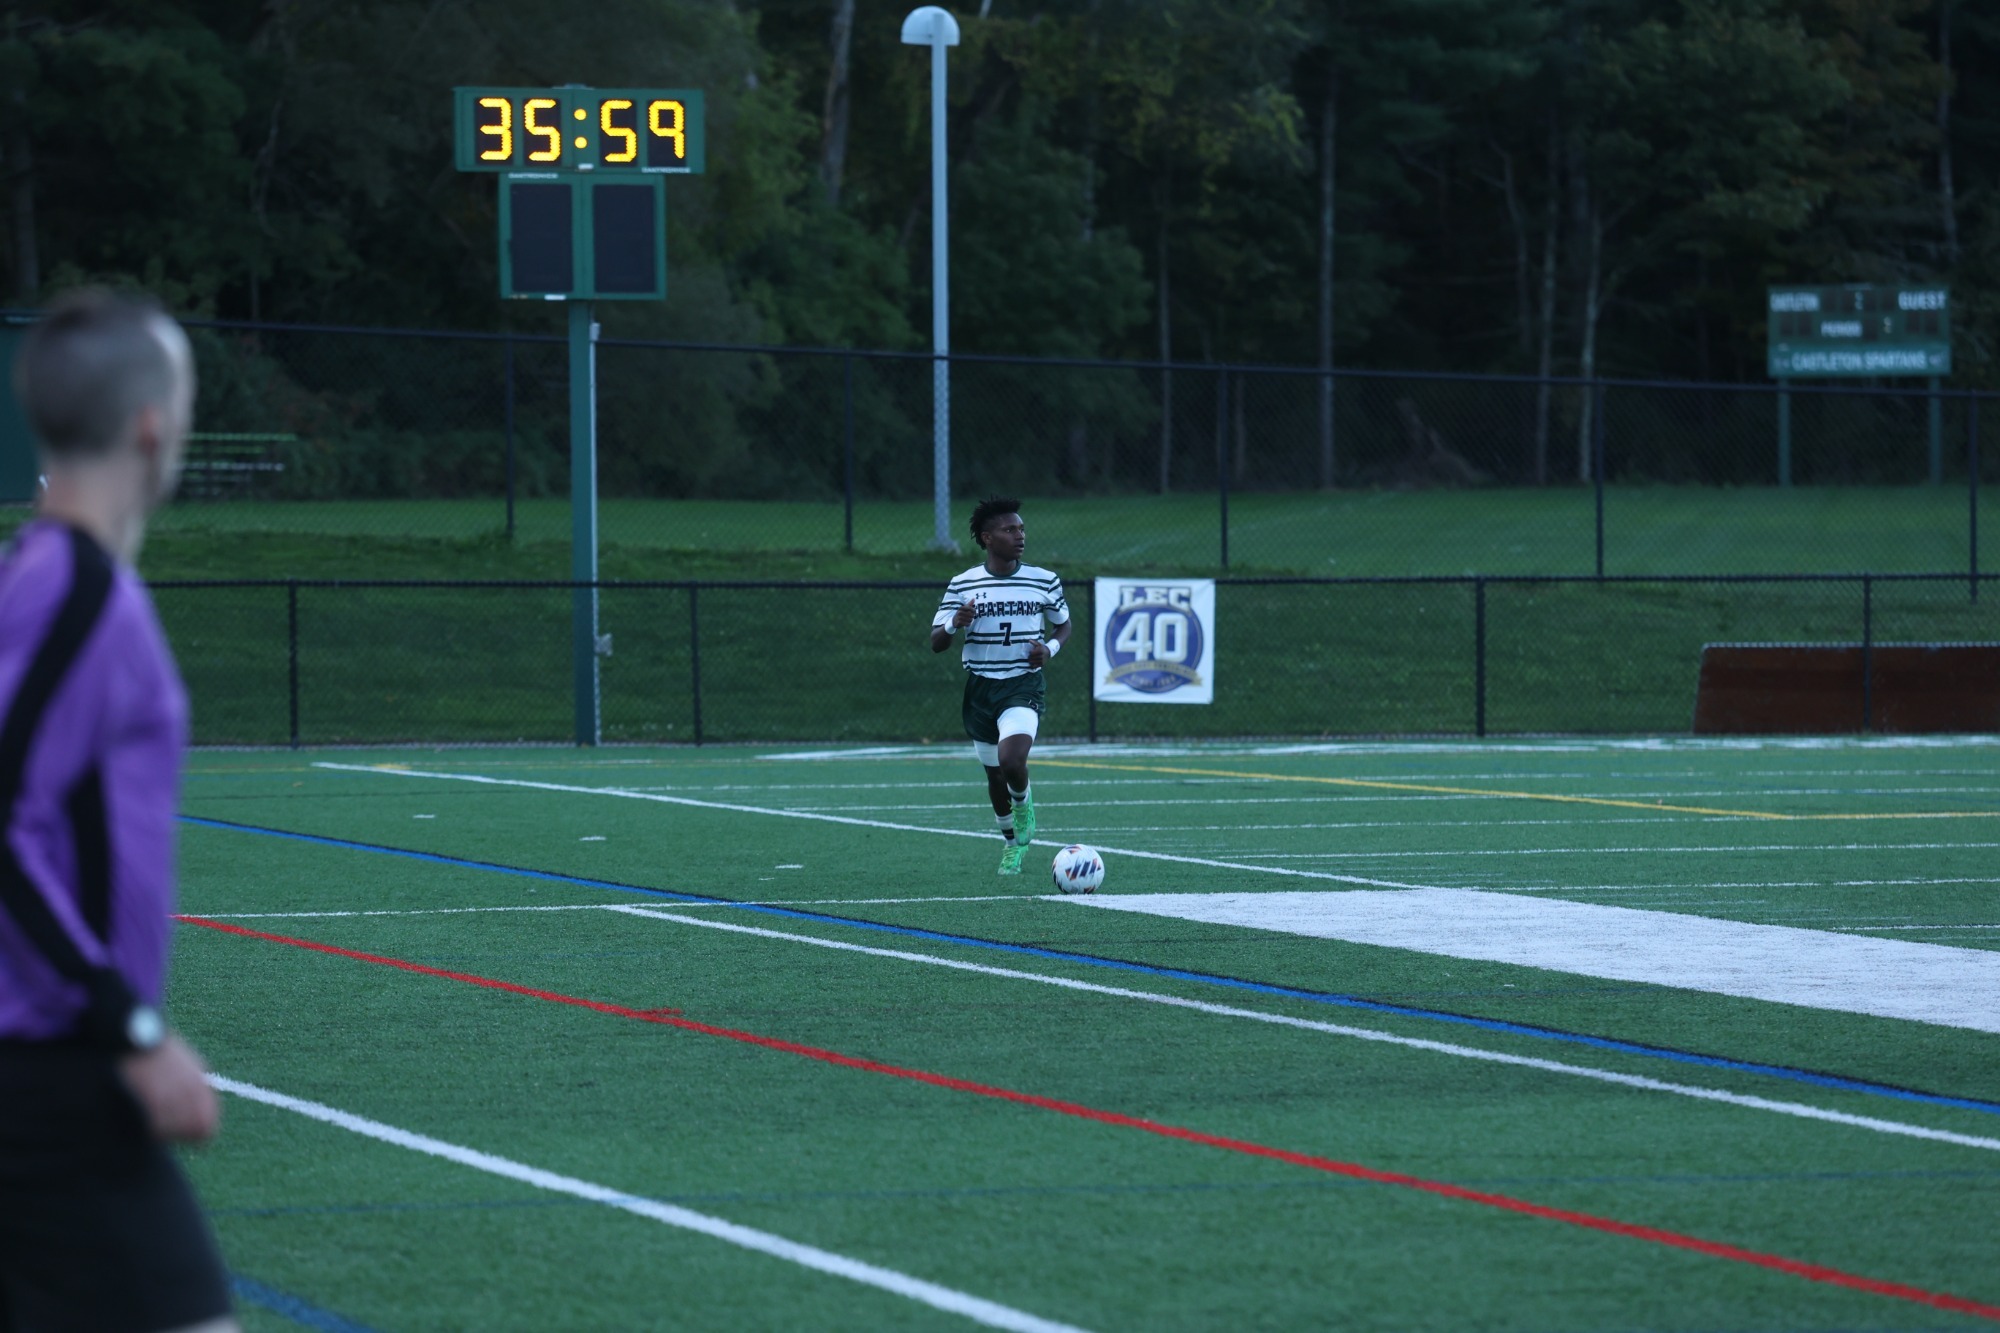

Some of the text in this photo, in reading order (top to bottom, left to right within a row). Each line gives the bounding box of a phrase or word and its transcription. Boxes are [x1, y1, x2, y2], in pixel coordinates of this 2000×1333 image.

[479, 98, 685, 163] 35:59
[1898, 290, 1946, 310] GUEST
[1791, 351, 1926, 371] CASTLETON SPARTANS
[1119, 586, 1192, 615] LEC
[999, 622, 1012, 646] 7
[1115, 611, 1189, 662] 40
